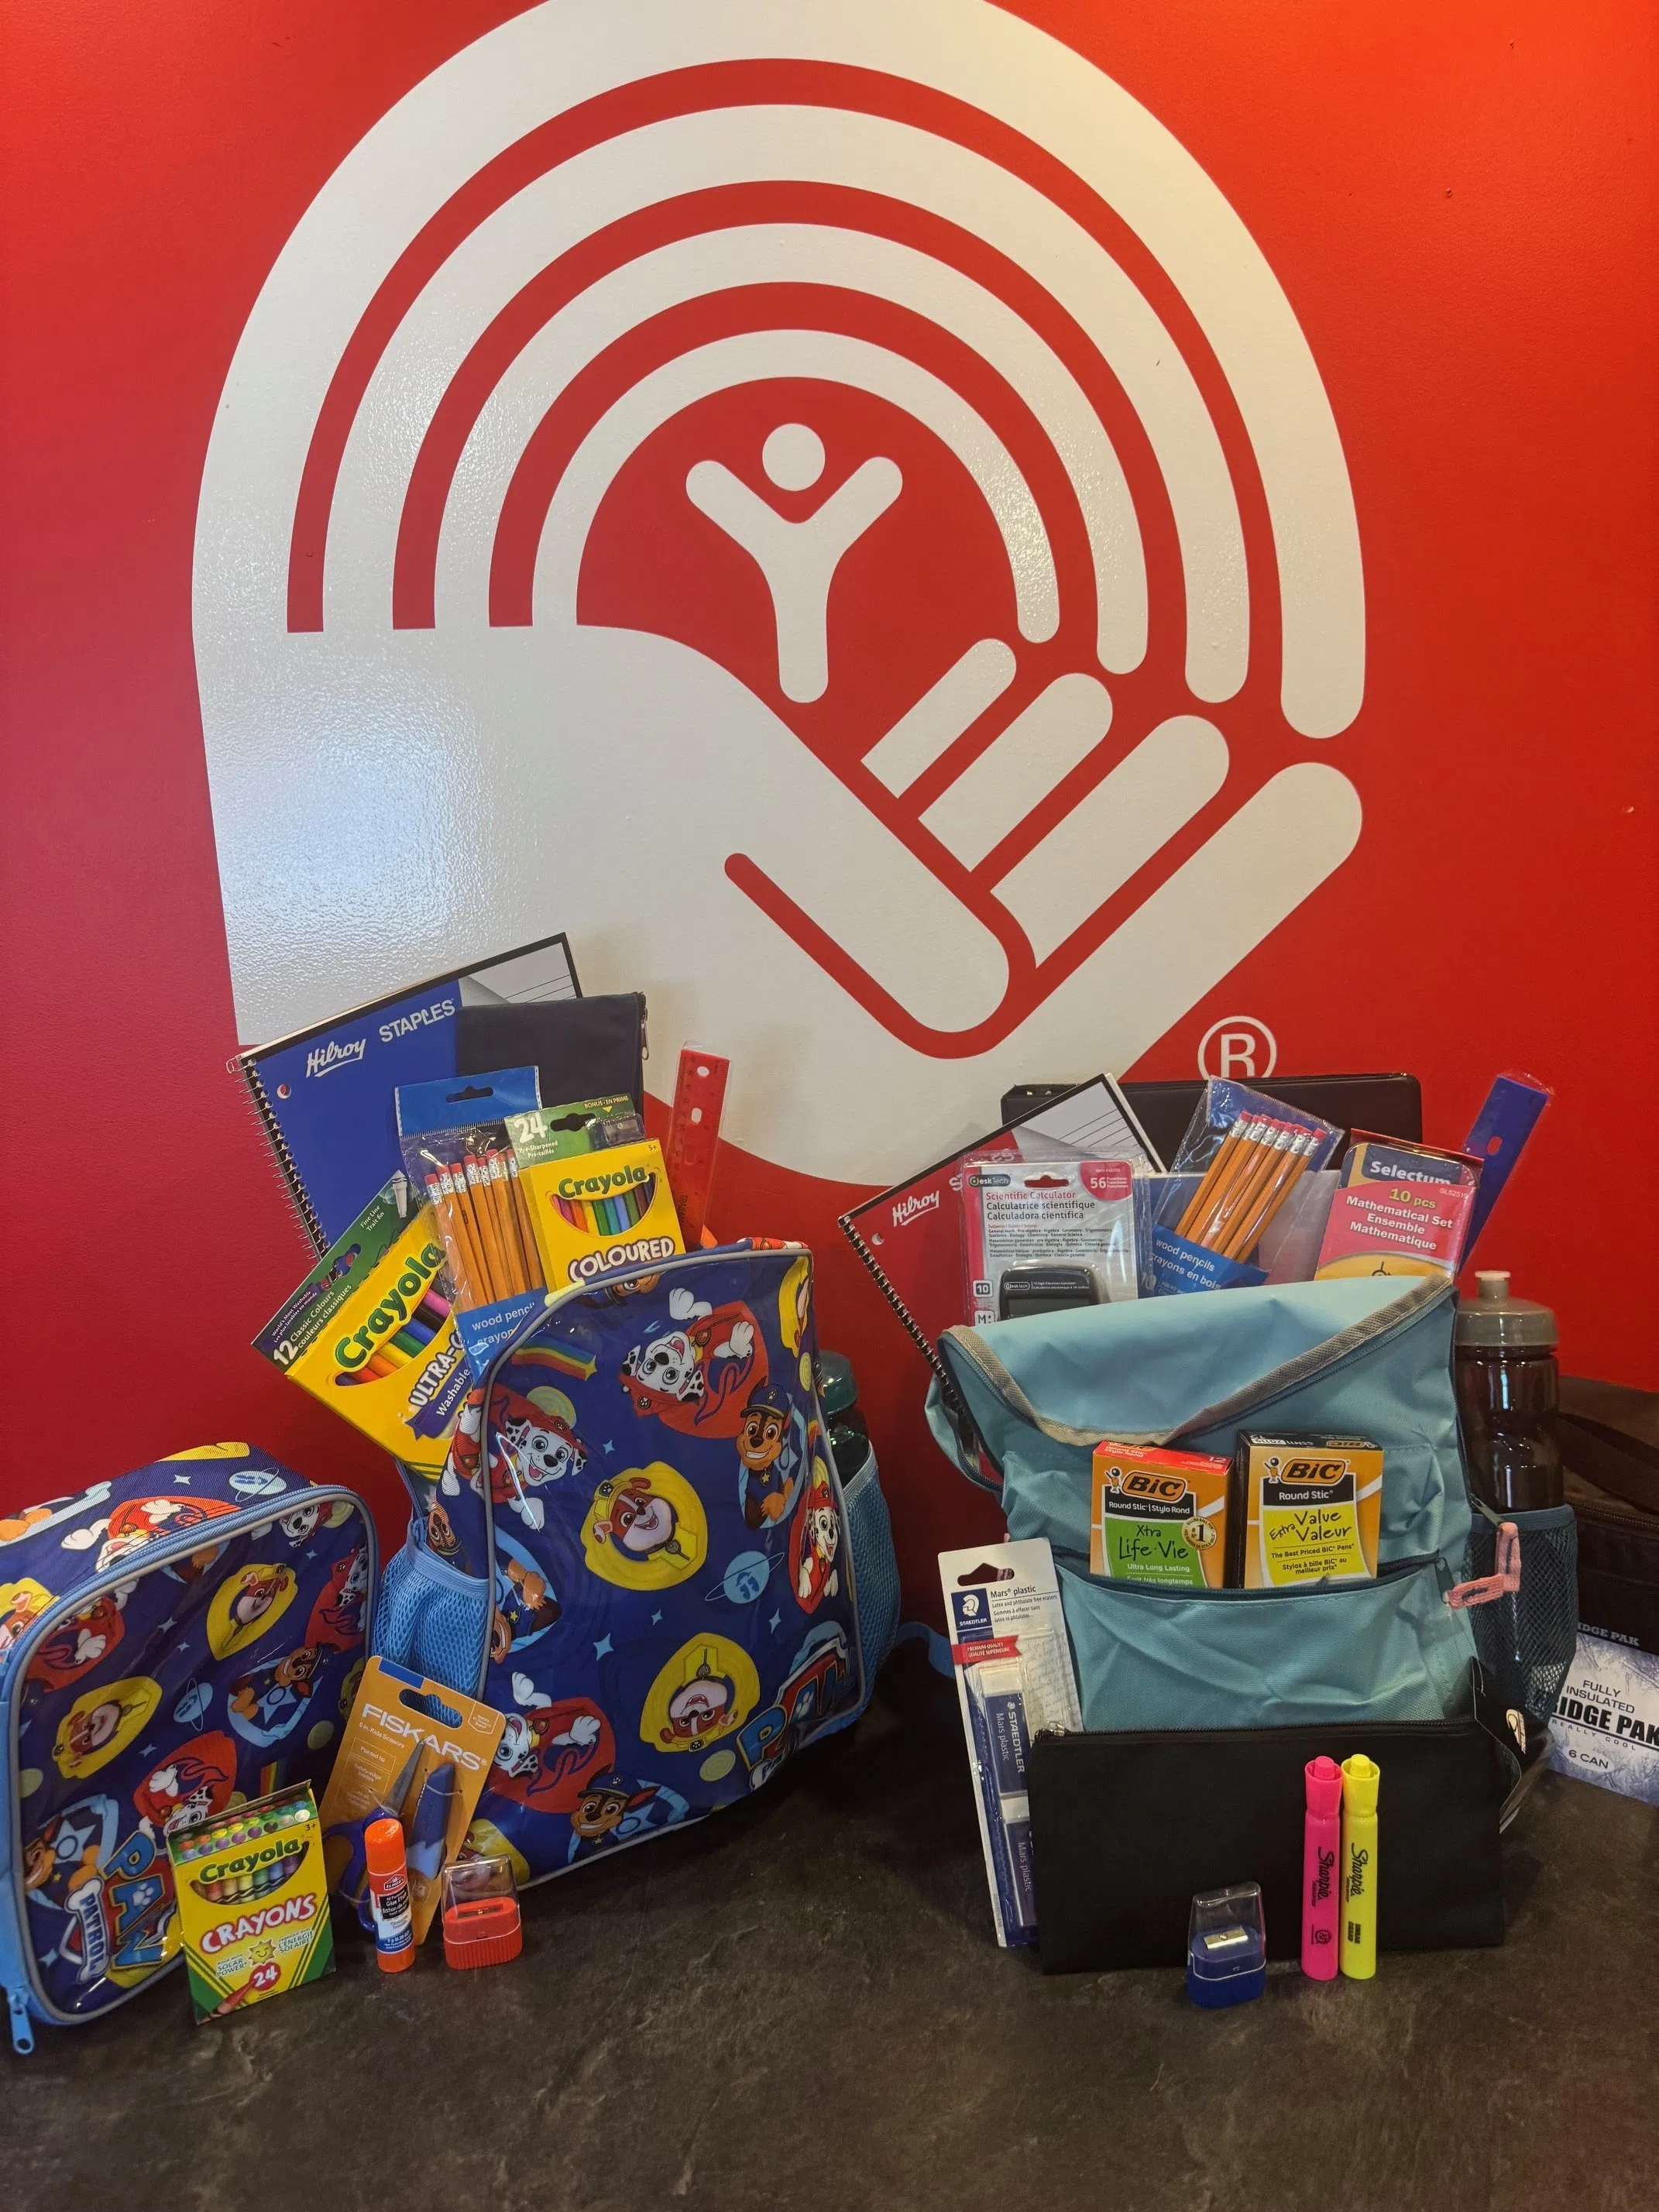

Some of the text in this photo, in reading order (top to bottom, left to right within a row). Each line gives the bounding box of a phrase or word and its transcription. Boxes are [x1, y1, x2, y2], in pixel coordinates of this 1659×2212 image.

[379, 999, 455, 1042] STAPLES
[305, 1039, 366, 1078] Hilroy
[584, 1100, 603, 1109] BONUS
[613, 1095, 629, 1104] PRIME
[514, 1111, 548, 1143] 24
[558, 1165, 647, 1199] Crayola
[1091, 1177, 1106, 1189] 56
[986, 1191, 1076, 1200] Scientific Calculator
[987, 1200, 1095, 1211] Calculatrice scientifique
[1389, 1188, 1436, 1208] 10 pcs
[360, 1205, 380, 1228] Fine Line
[892, 1190, 940, 1228] Hilroy
[988, 1212, 1039, 1221] Calculadora
[1347, 1195, 1453, 1229] Mathematical Set
[366, 1218, 378, 1232] Trait
[1367, 1213, 1426, 1235] Ensemble
[1350, 1221, 1437, 1250] Mathematique
[569, 1238, 675, 1283] COLOURED
[1156, 1239, 1215, 1272] wood pencils
[977, 1284, 989, 1293] 10
[1187, 1271, 1200, 1282] en
[1200, 1276, 1222, 1290] bois
[290, 1290, 335, 1342] Classic Colours
[297, 1284, 352, 1349] couleurs classiques
[335, 1243, 446, 1369] Crayola
[471, 1314, 503, 1331] wood
[273, 1340, 299, 1366] 12
[436, 1368, 471, 1417] Washable
[1109, 1501, 1132, 1510] Round
[1279, 1491, 1309, 1501] Round
[1152, 1503, 1171, 1514] Stylo
[1294, 1509, 1341, 1527] Value
[1136, 1524, 1162, 1537] Xtra
[1269, 1523, 1297, 1540] Extra
[1296, 1526, 1352, 1542] Valeur
[1119, 1536, 1189, 1561] Life Vie
[1165, 1565, 1190, 1573] Lasting
[1282, 1562, 1302, 1571] Stylos
[1013, 1585, 1036, 1596] plastic
[1157, 1577, 1194, 1586] longtemps
[959, 1617, 988, 1627] STAEDTLER
[1582, 1679, 1621, 1698] FULLY
[1566, 1685, 1636, 1715] INSULATED
[1555, 1696, 1611, 1731] IDGE
[996, 1712, 1010, 1761] Mars plastic
[1008, 1711, 1025, 1774] STAEDTLER
[1551, 1719, 1636, 1751] REALLY COOL
[360, 1746, 379, 1760] Pointed
[1568, 1750, 1609, 1770] 6 CAN
[305, 1822, 317, 1832] 3+
[200, 1837, 300, 1883] Crayola
[1018, 1842, 1032, 1892] Mars plastic
[1351, 1843, 1369, 1898] Sharpie
[1317, 1846, 1334, 1901] Sharpie
[80, 1893, 105, 1971] PATROL
[201, 1894, 316, 1953] CRAYONS
[218, 1958, 243, 1971] SOLAR
[253, 1965, 277, 1987] 24
